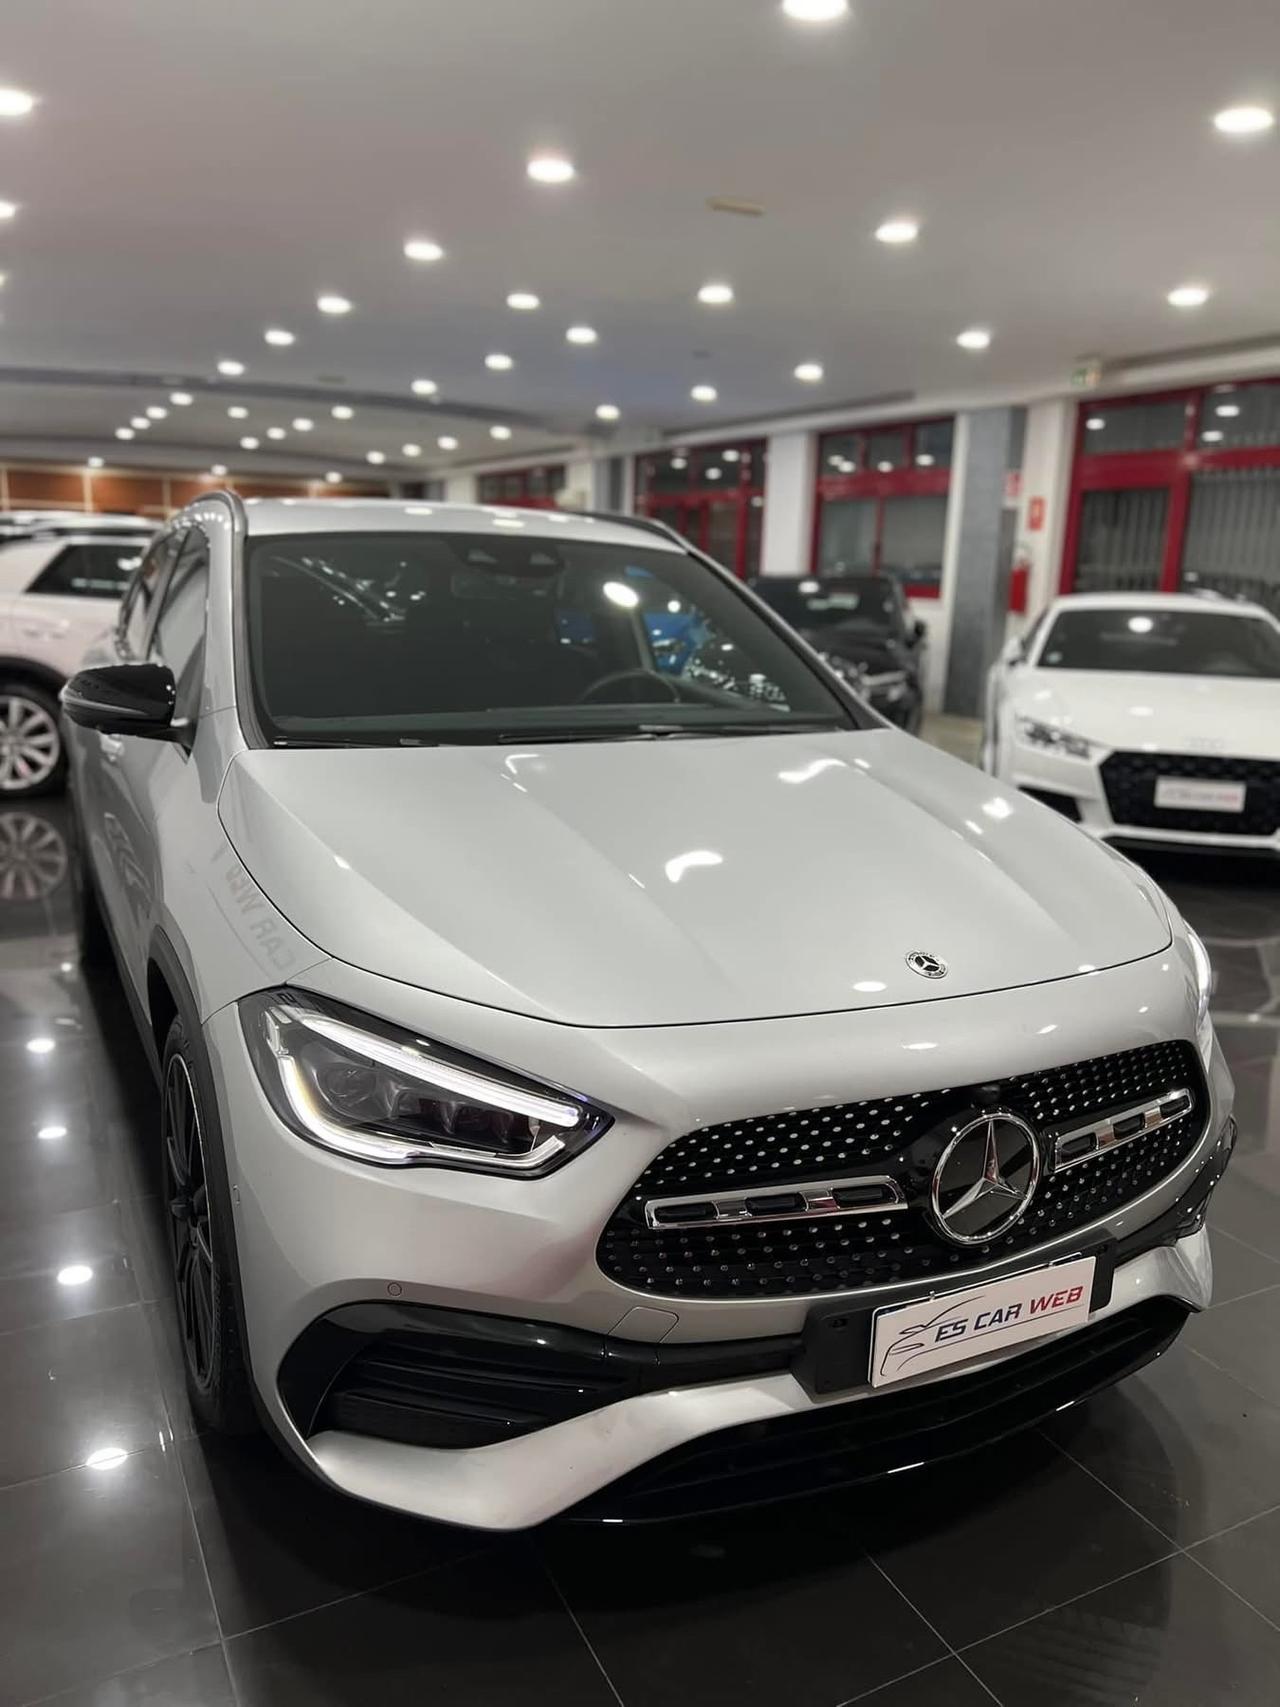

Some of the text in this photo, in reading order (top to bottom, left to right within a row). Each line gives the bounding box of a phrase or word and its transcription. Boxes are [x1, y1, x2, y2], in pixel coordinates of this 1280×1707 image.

[935, 1286, 1083, 1342] ES CAR WEB
